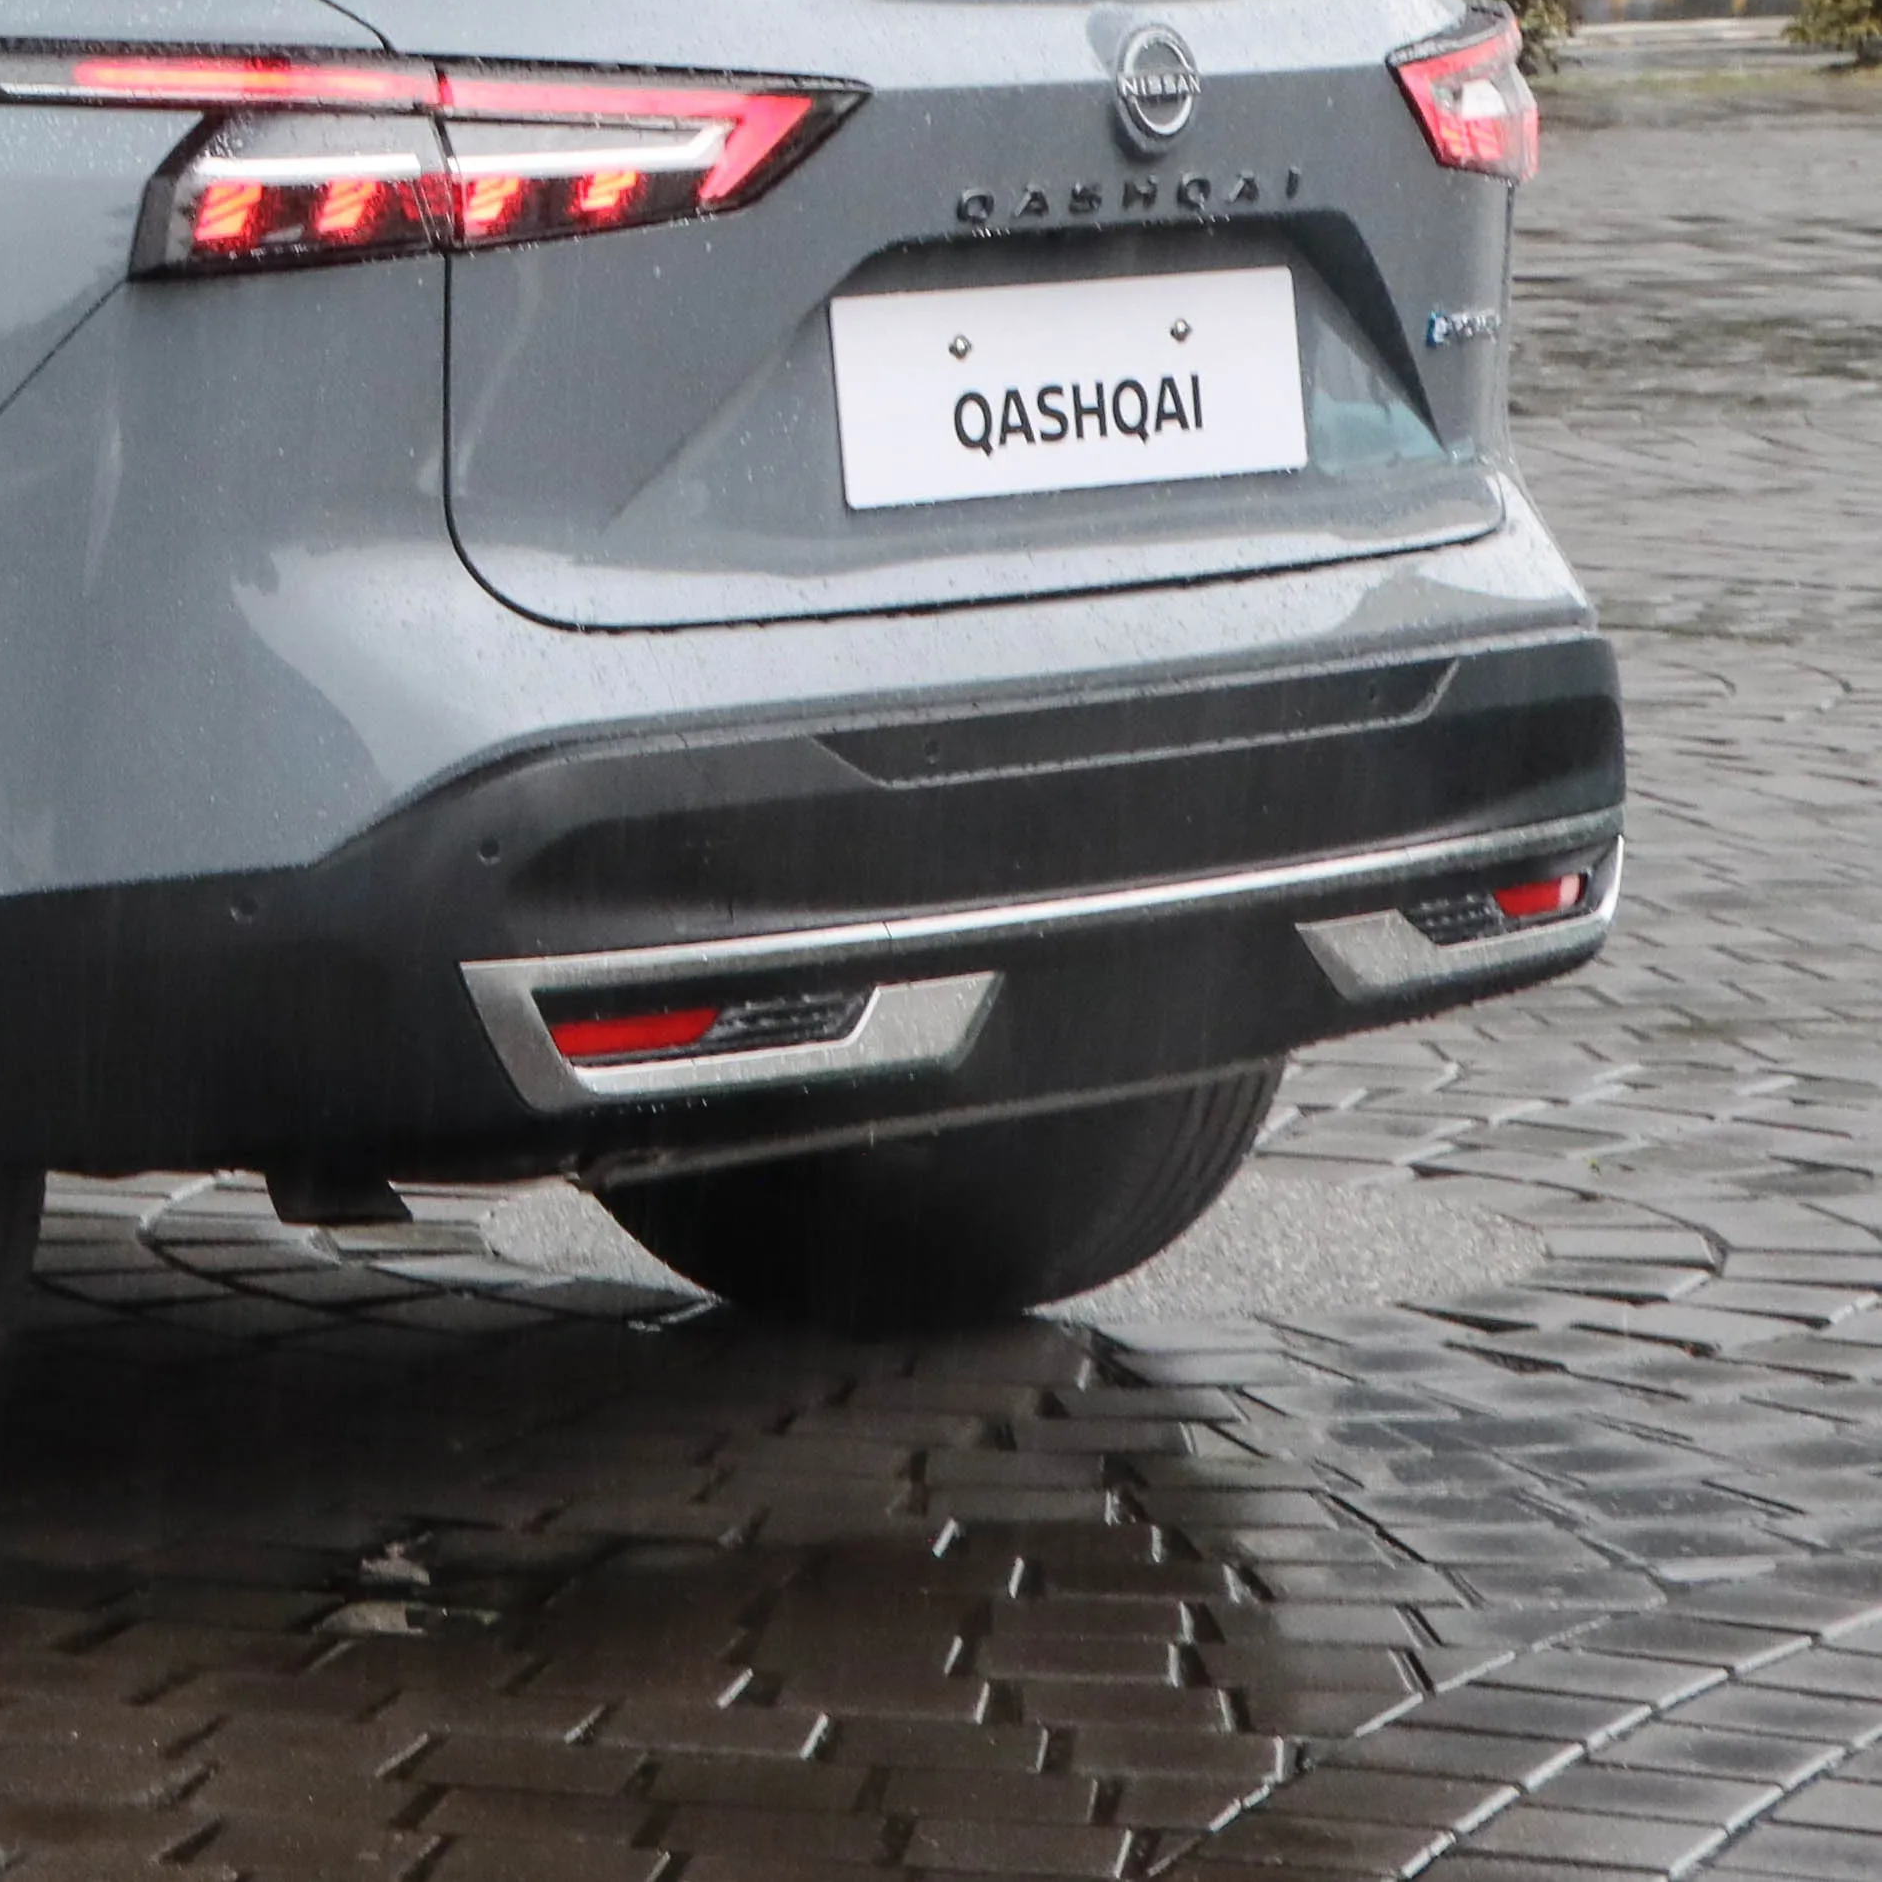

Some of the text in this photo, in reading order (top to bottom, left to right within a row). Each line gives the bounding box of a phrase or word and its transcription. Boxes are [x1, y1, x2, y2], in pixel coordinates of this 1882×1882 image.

[1116, 71, 1202, 97] NISSAN
[956, 165, 1302, 224] QASHQAI
[953, 371, 1204, 458] QASHQAI
